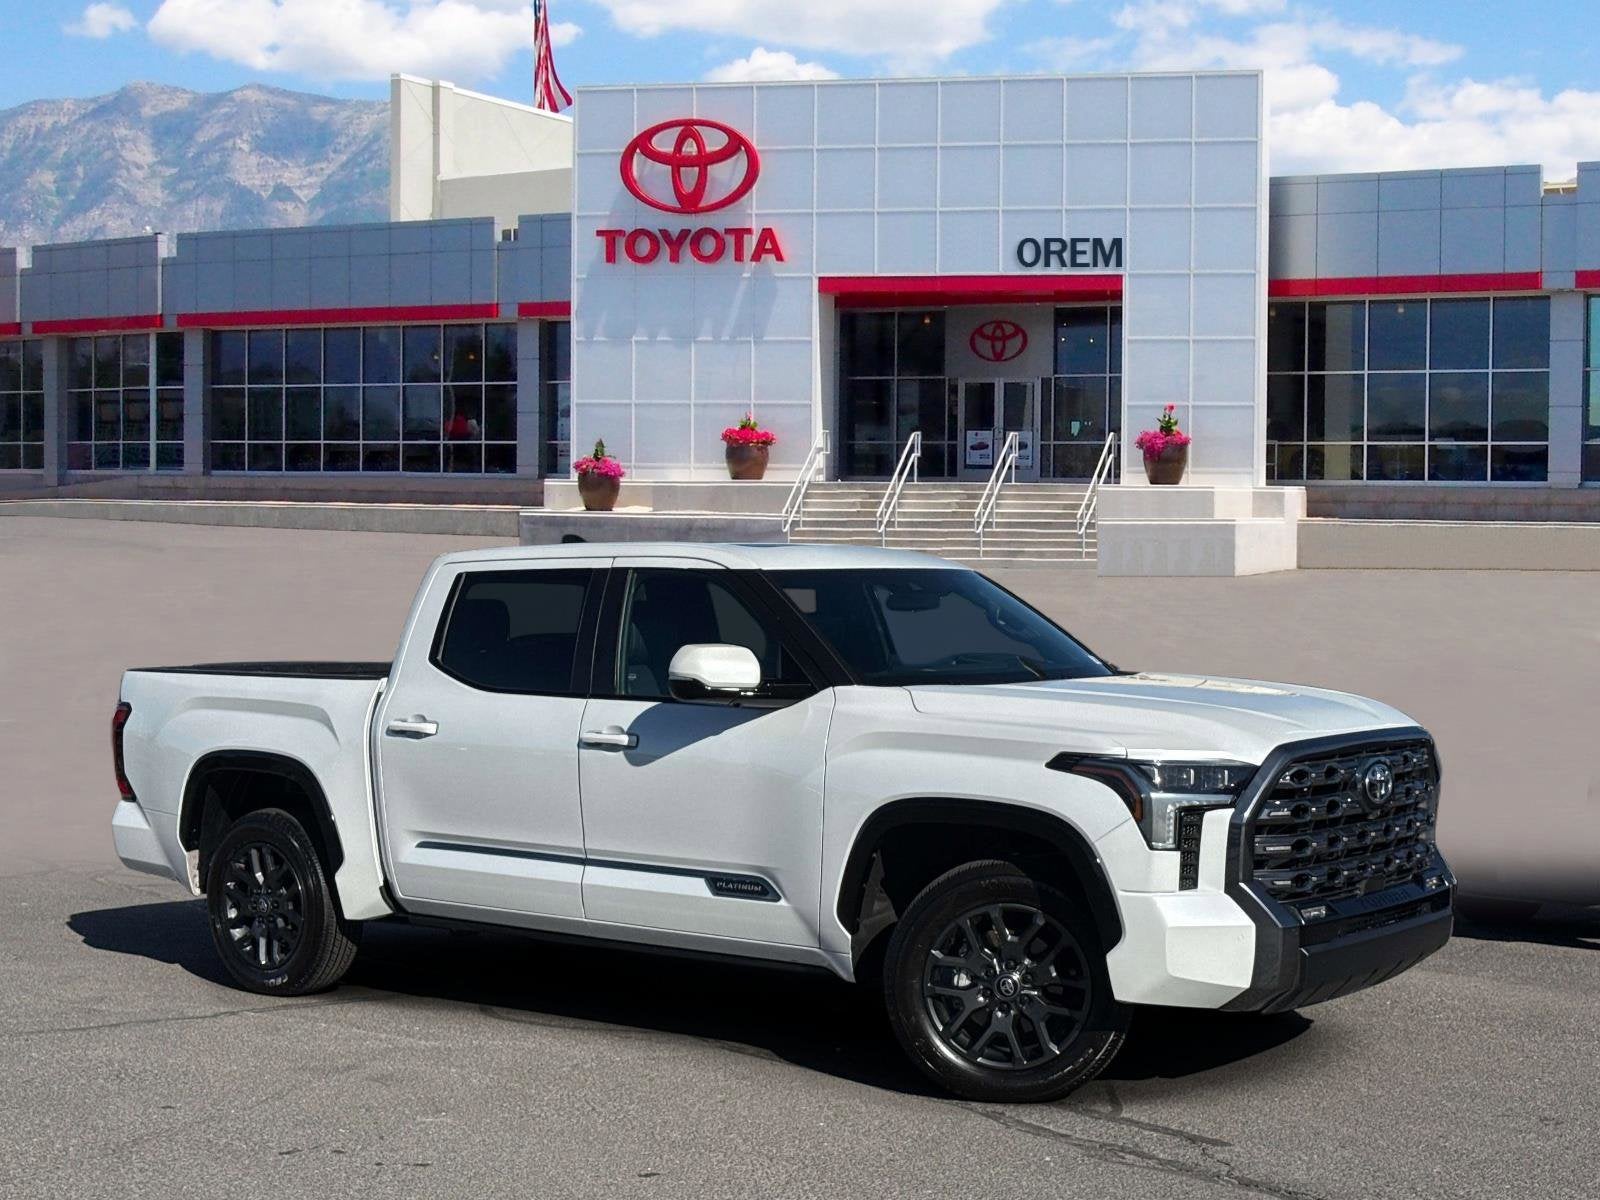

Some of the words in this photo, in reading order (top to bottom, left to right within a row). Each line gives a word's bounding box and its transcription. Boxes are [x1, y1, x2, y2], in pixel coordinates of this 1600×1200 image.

[596, 227, 784, 264] TOYOTA
[1017, 237, 1123, 268] OREM
[716, 881, 762, 892] PLATINUM
